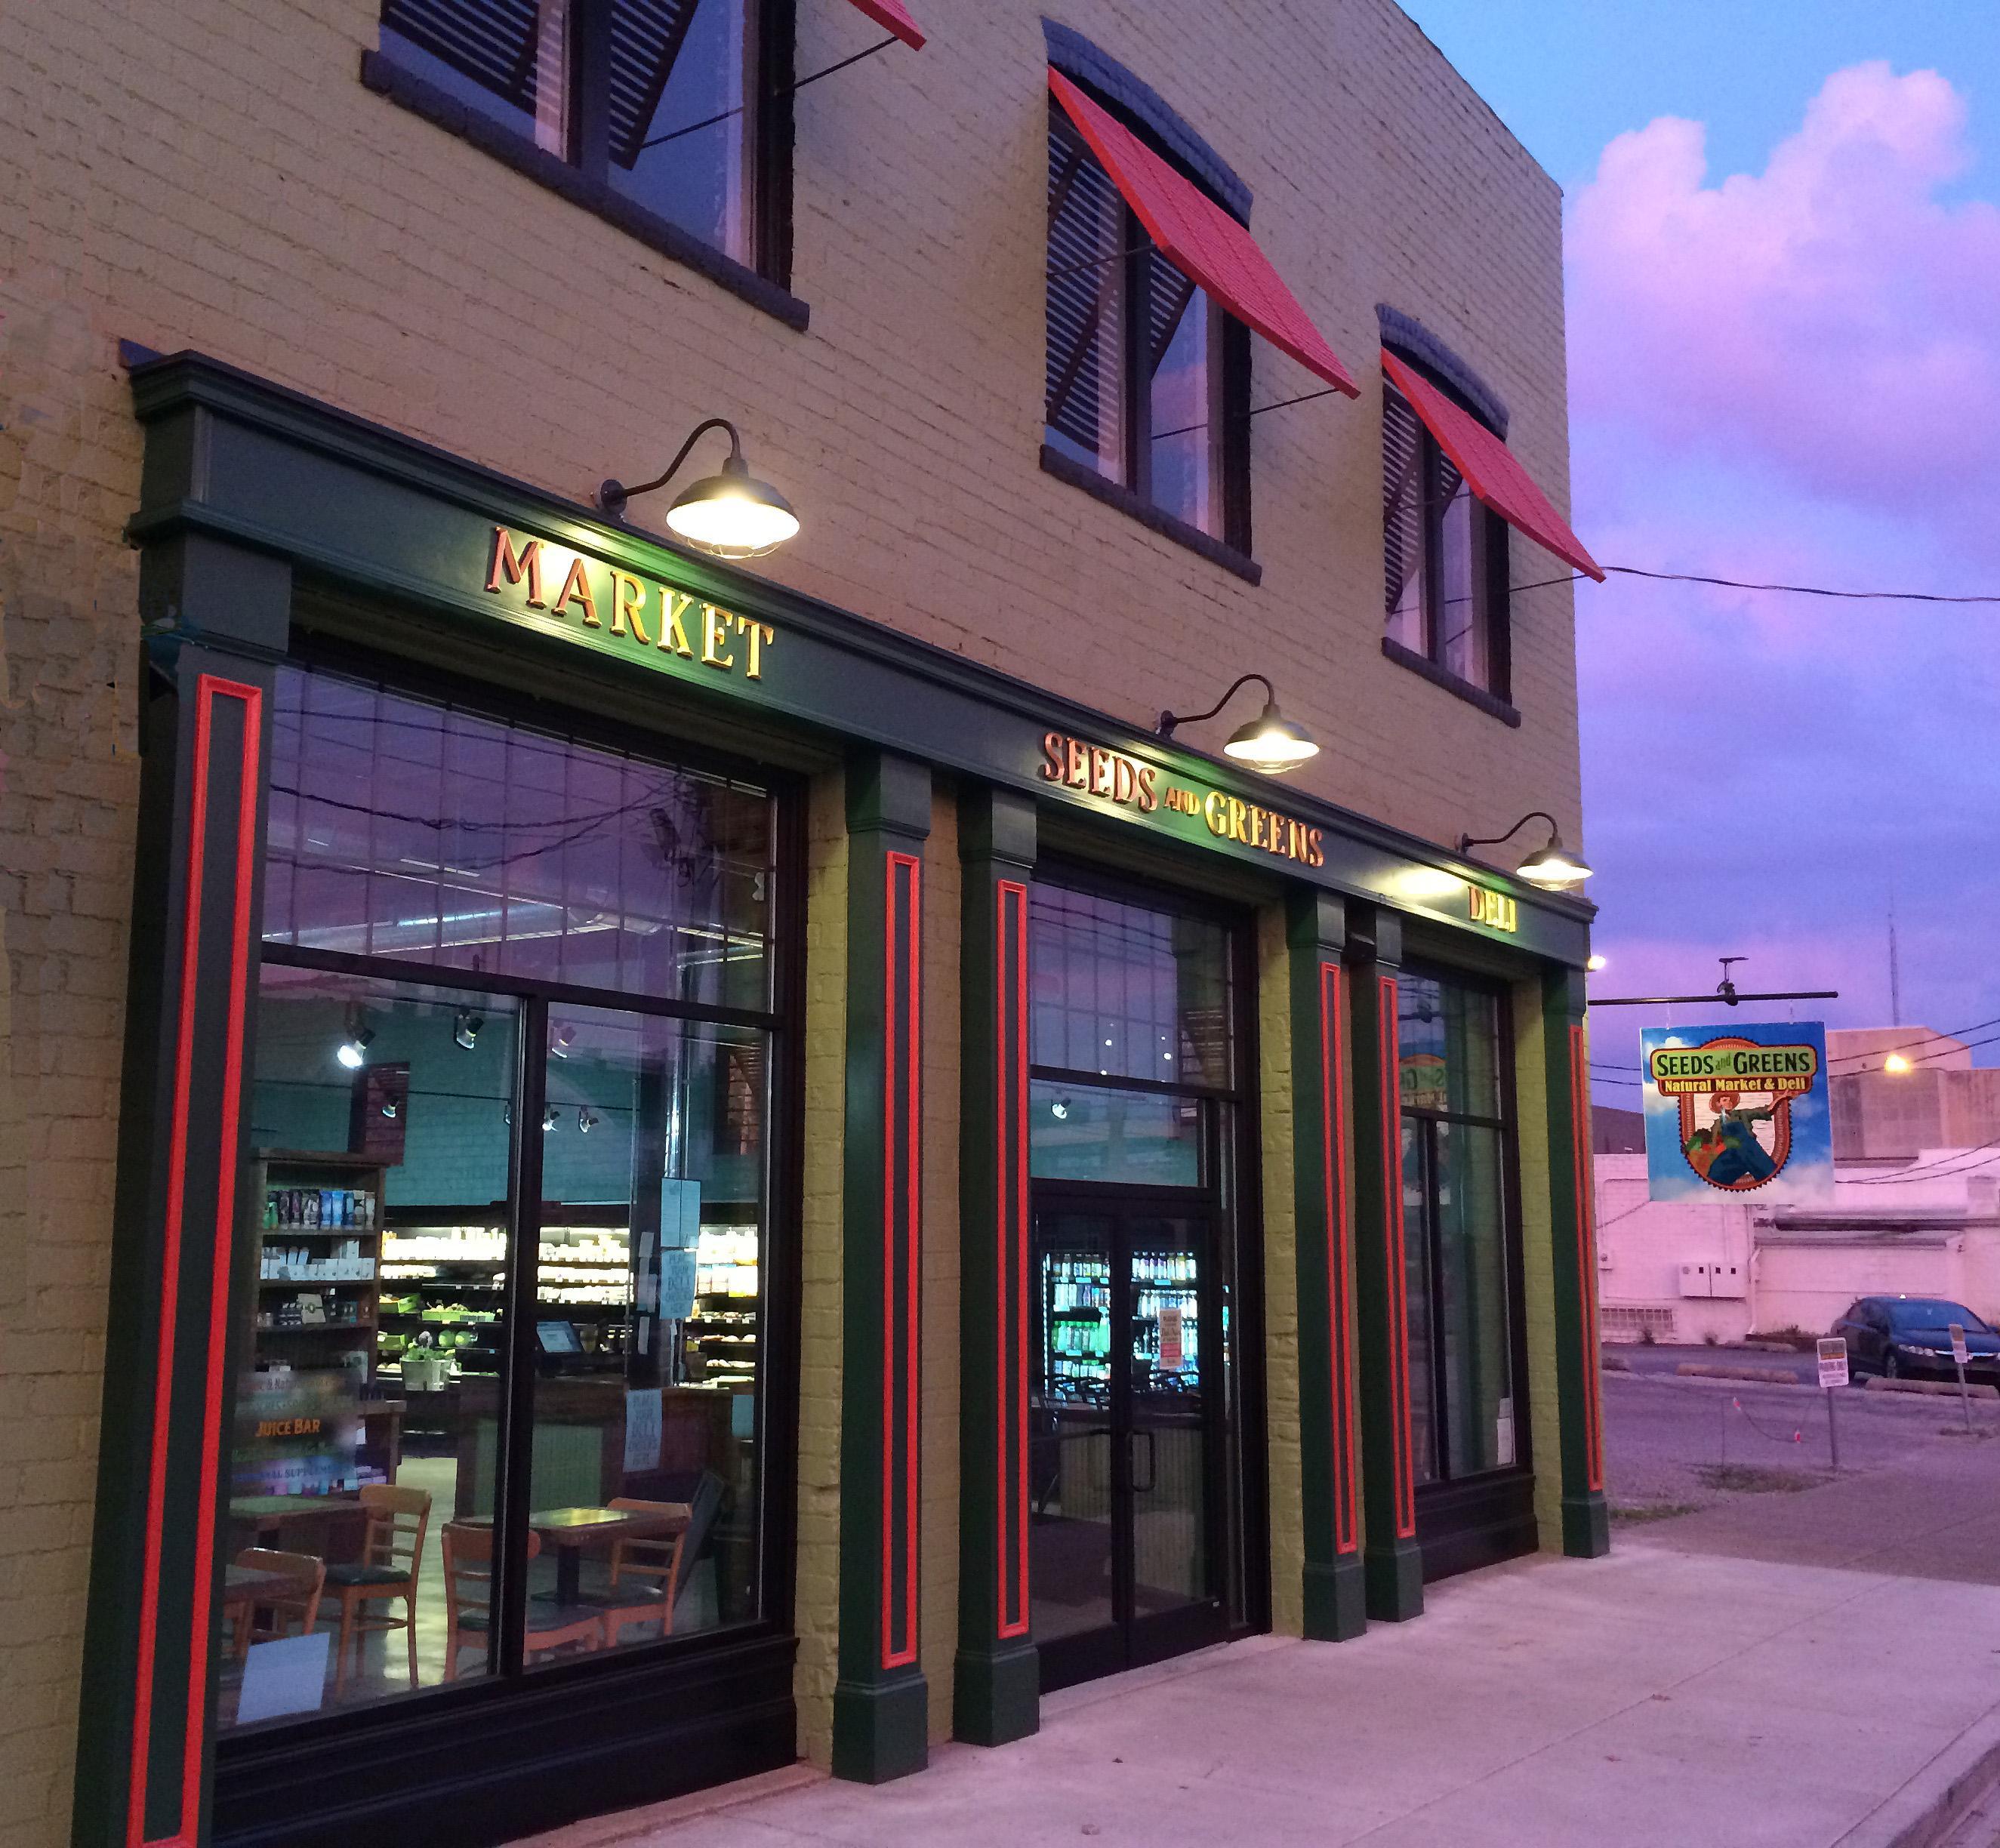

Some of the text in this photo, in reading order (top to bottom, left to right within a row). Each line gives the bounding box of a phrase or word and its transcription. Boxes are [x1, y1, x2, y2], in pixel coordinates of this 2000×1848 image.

[485, 526, 775, 679] MARKET
[1044, 732, 1324, 868] SEEDS AND GREENS
[1468, 885, 1518, 933] DELI
[1656, 1052, 1810, 1076] SEEDS and GREENS
[1665, 1077, 1805, 1092] Natural Market & Deli
[254, 1418, 320, 1437] JUICE BAR
